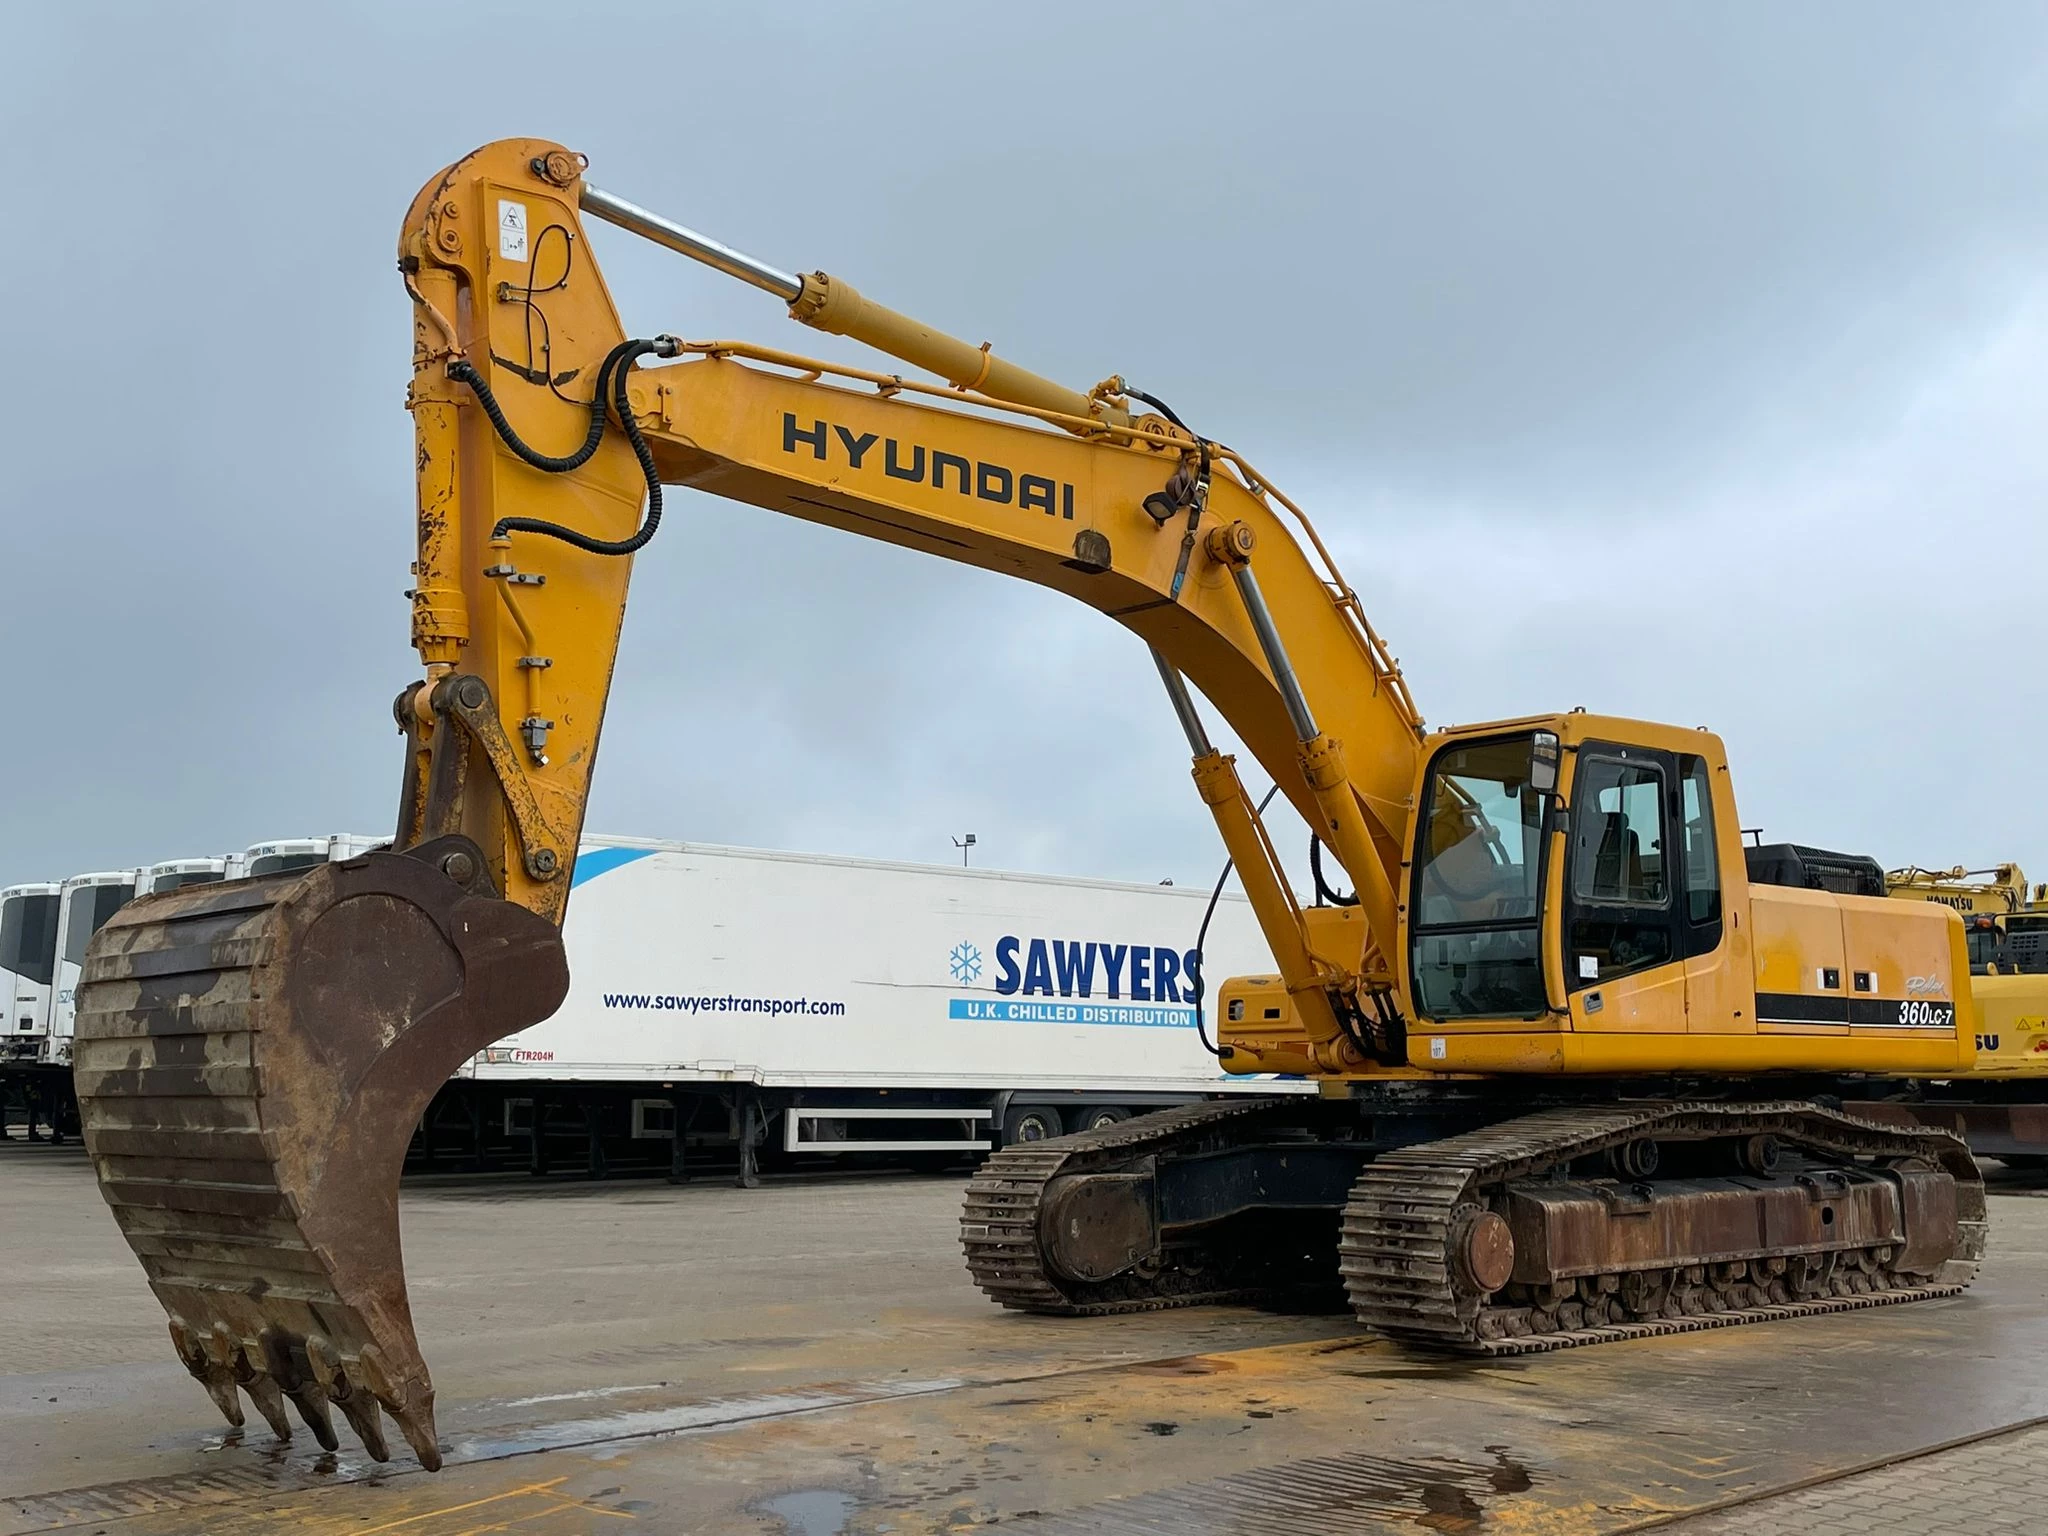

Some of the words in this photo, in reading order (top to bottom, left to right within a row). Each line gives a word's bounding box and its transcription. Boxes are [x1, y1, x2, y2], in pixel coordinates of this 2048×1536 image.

[783, 411, 1074, 520] HYUNDAI
[995, 935, 1205, 1004] SAWYERS
[603, 993, 845, 1017] www.sawyerstransport.com
[967, 1002, 1001, 1018] U.K.
[1008, 1004, 1077, 1021] CHILLED
[1083, 1007, 1190, 1026] DISTRIBUTION
[515, 1051, 554, 1061] FTR204H
